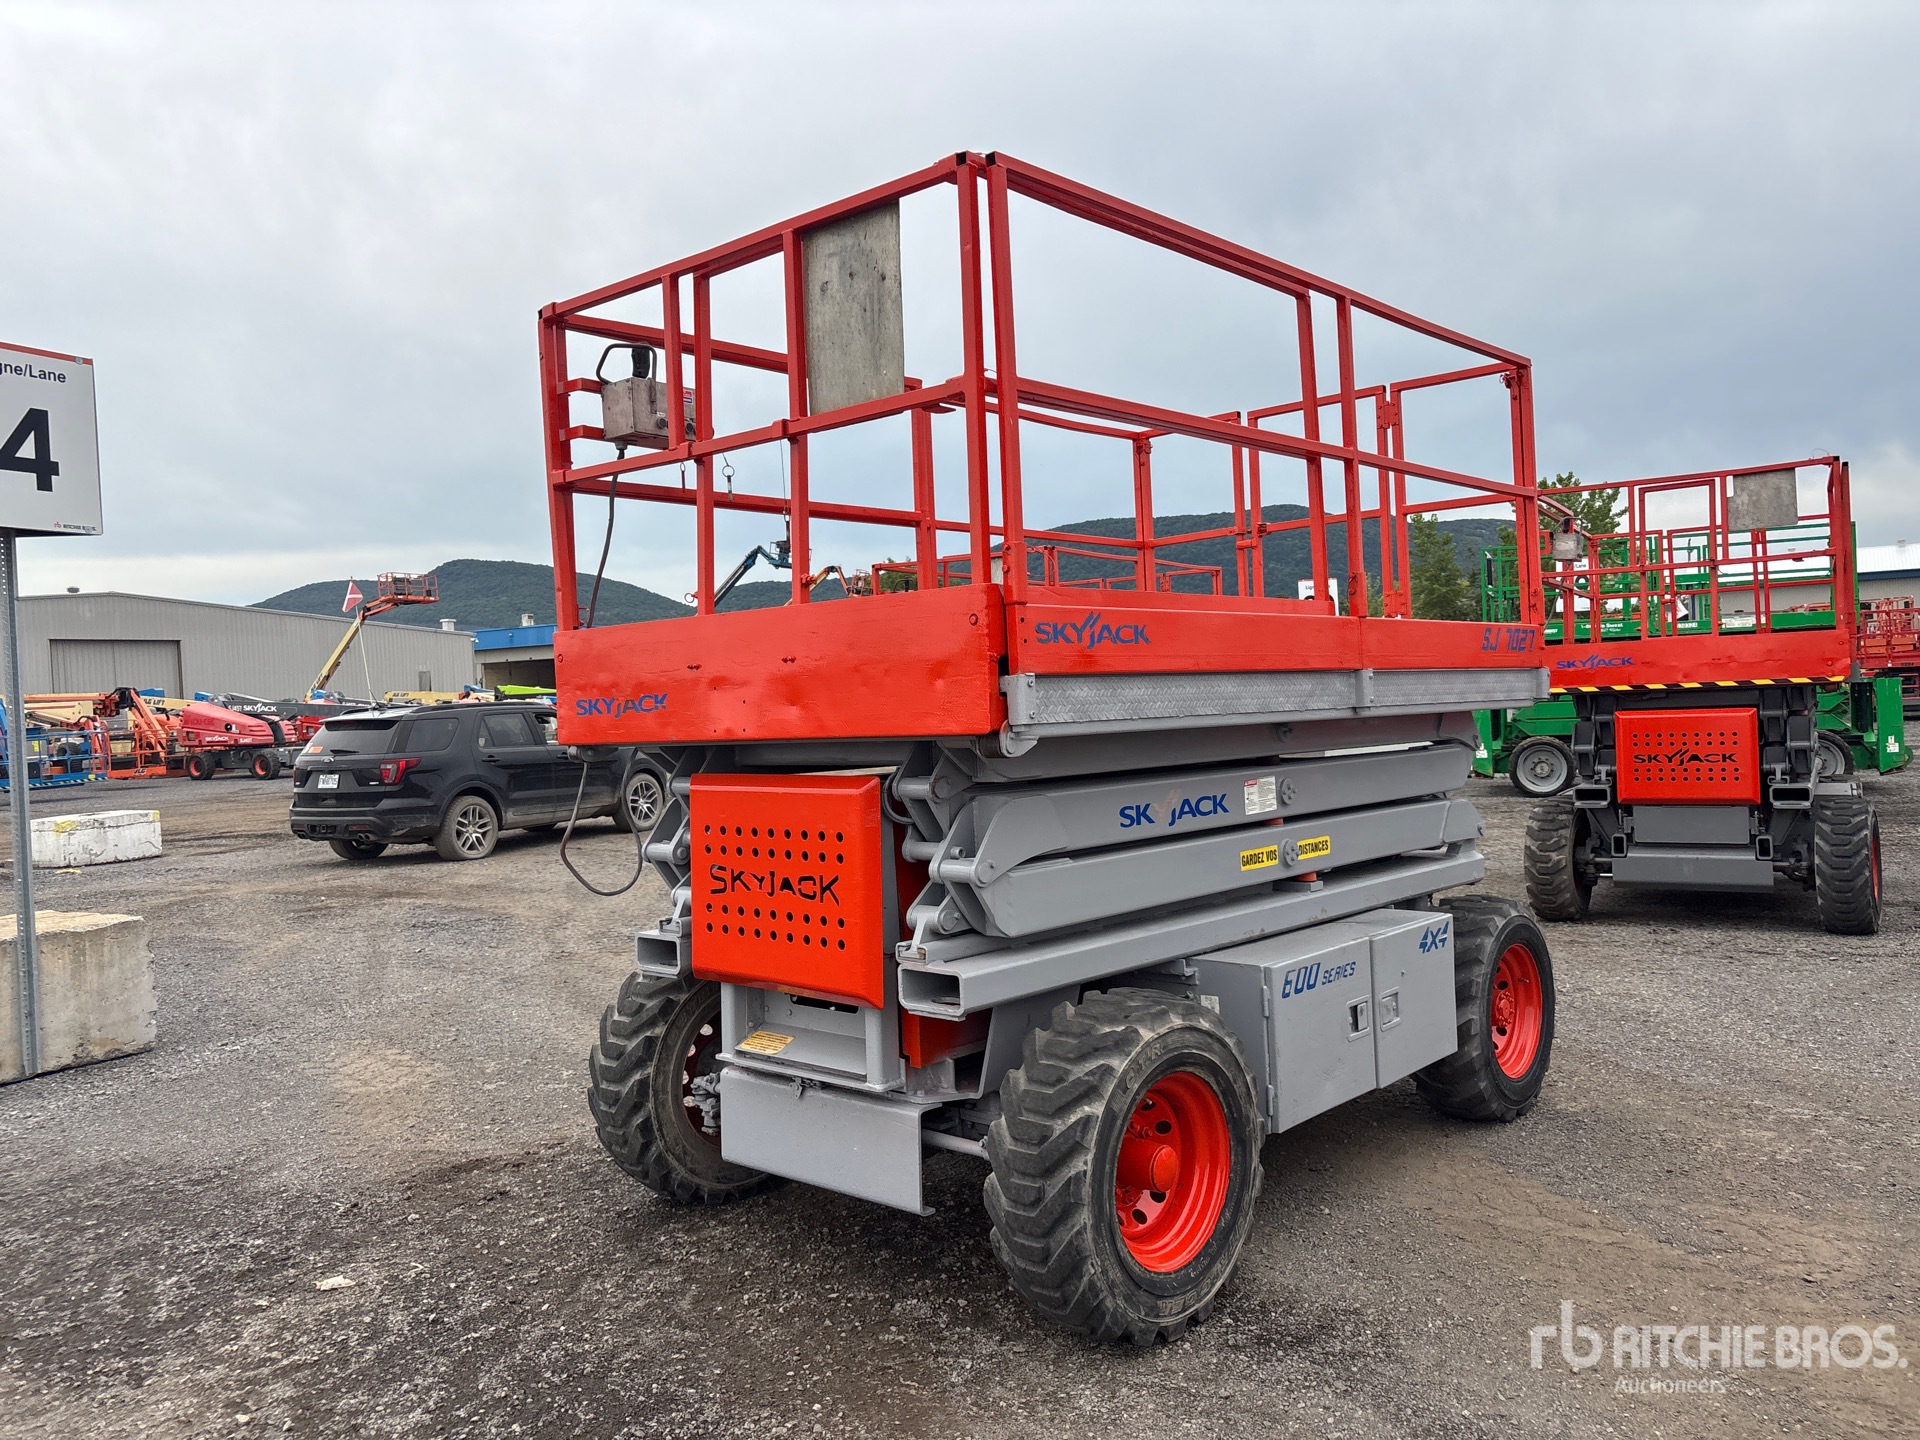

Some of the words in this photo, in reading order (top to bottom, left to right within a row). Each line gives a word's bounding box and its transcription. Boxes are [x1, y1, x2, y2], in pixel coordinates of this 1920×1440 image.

[0, 407, 60, 492] 4
[1035, 611, 1151, 650] SKYJACK
[1482, 627, 1501, 651] SJ
[1506, 628, 1535, 652] 7027
[1556, 654, 1634, 669] SKYJACK
[243, 702, 277, 713] SKYJACK
[576, 692, 668, 719] SKYJACK
[1633, 748, 1738, 766] SKYJACK
[1241, 851, 1264, 867] GARDEZ
[1266, 849, 1278, 862] VOS
[1298, 839, 1329, 856] DISTANCES
[709, 864, 840, 907] SKYJACK
[1418, 921, 1450, 954] 4X4
[1281, 962, 1321, 999] 600
[1321, 961, 1357, 986] SERIES
